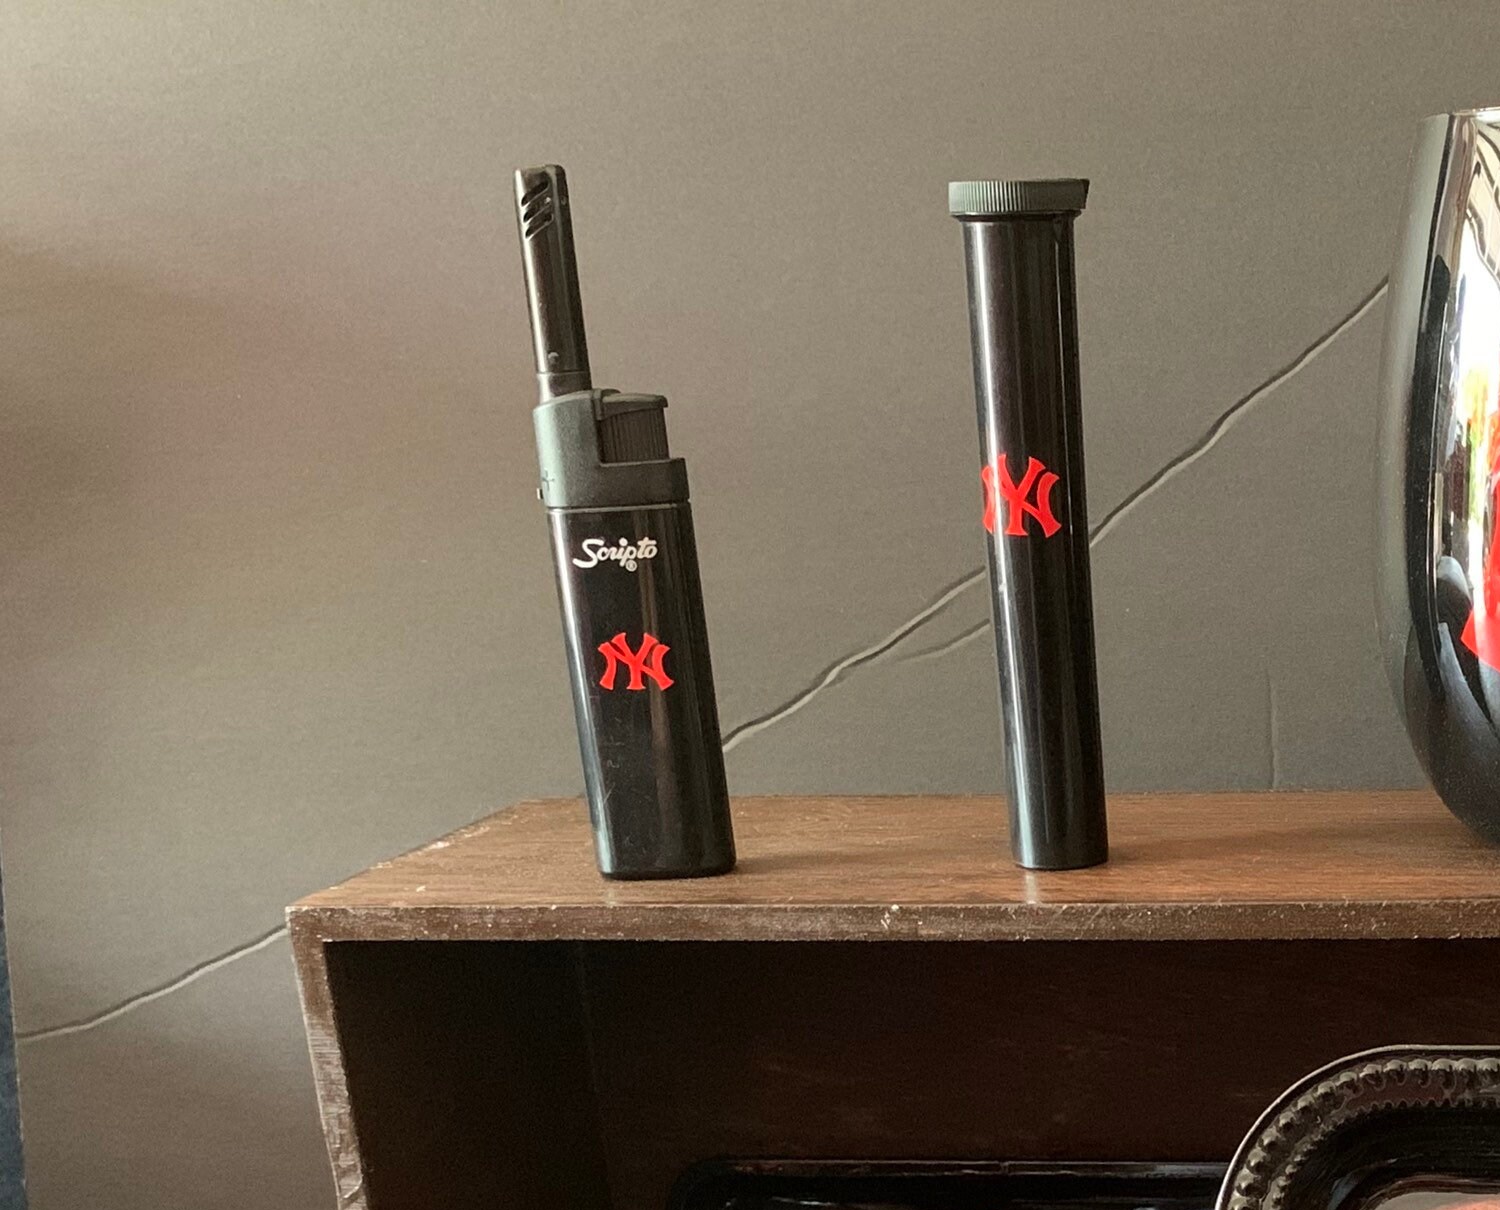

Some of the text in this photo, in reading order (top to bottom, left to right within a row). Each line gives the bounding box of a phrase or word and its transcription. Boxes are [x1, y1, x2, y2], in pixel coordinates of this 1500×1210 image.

[980, 453, 1062, 538] NY
[572, 536, 659, 569] Scripto
[597, 632, 675, 691] NY
